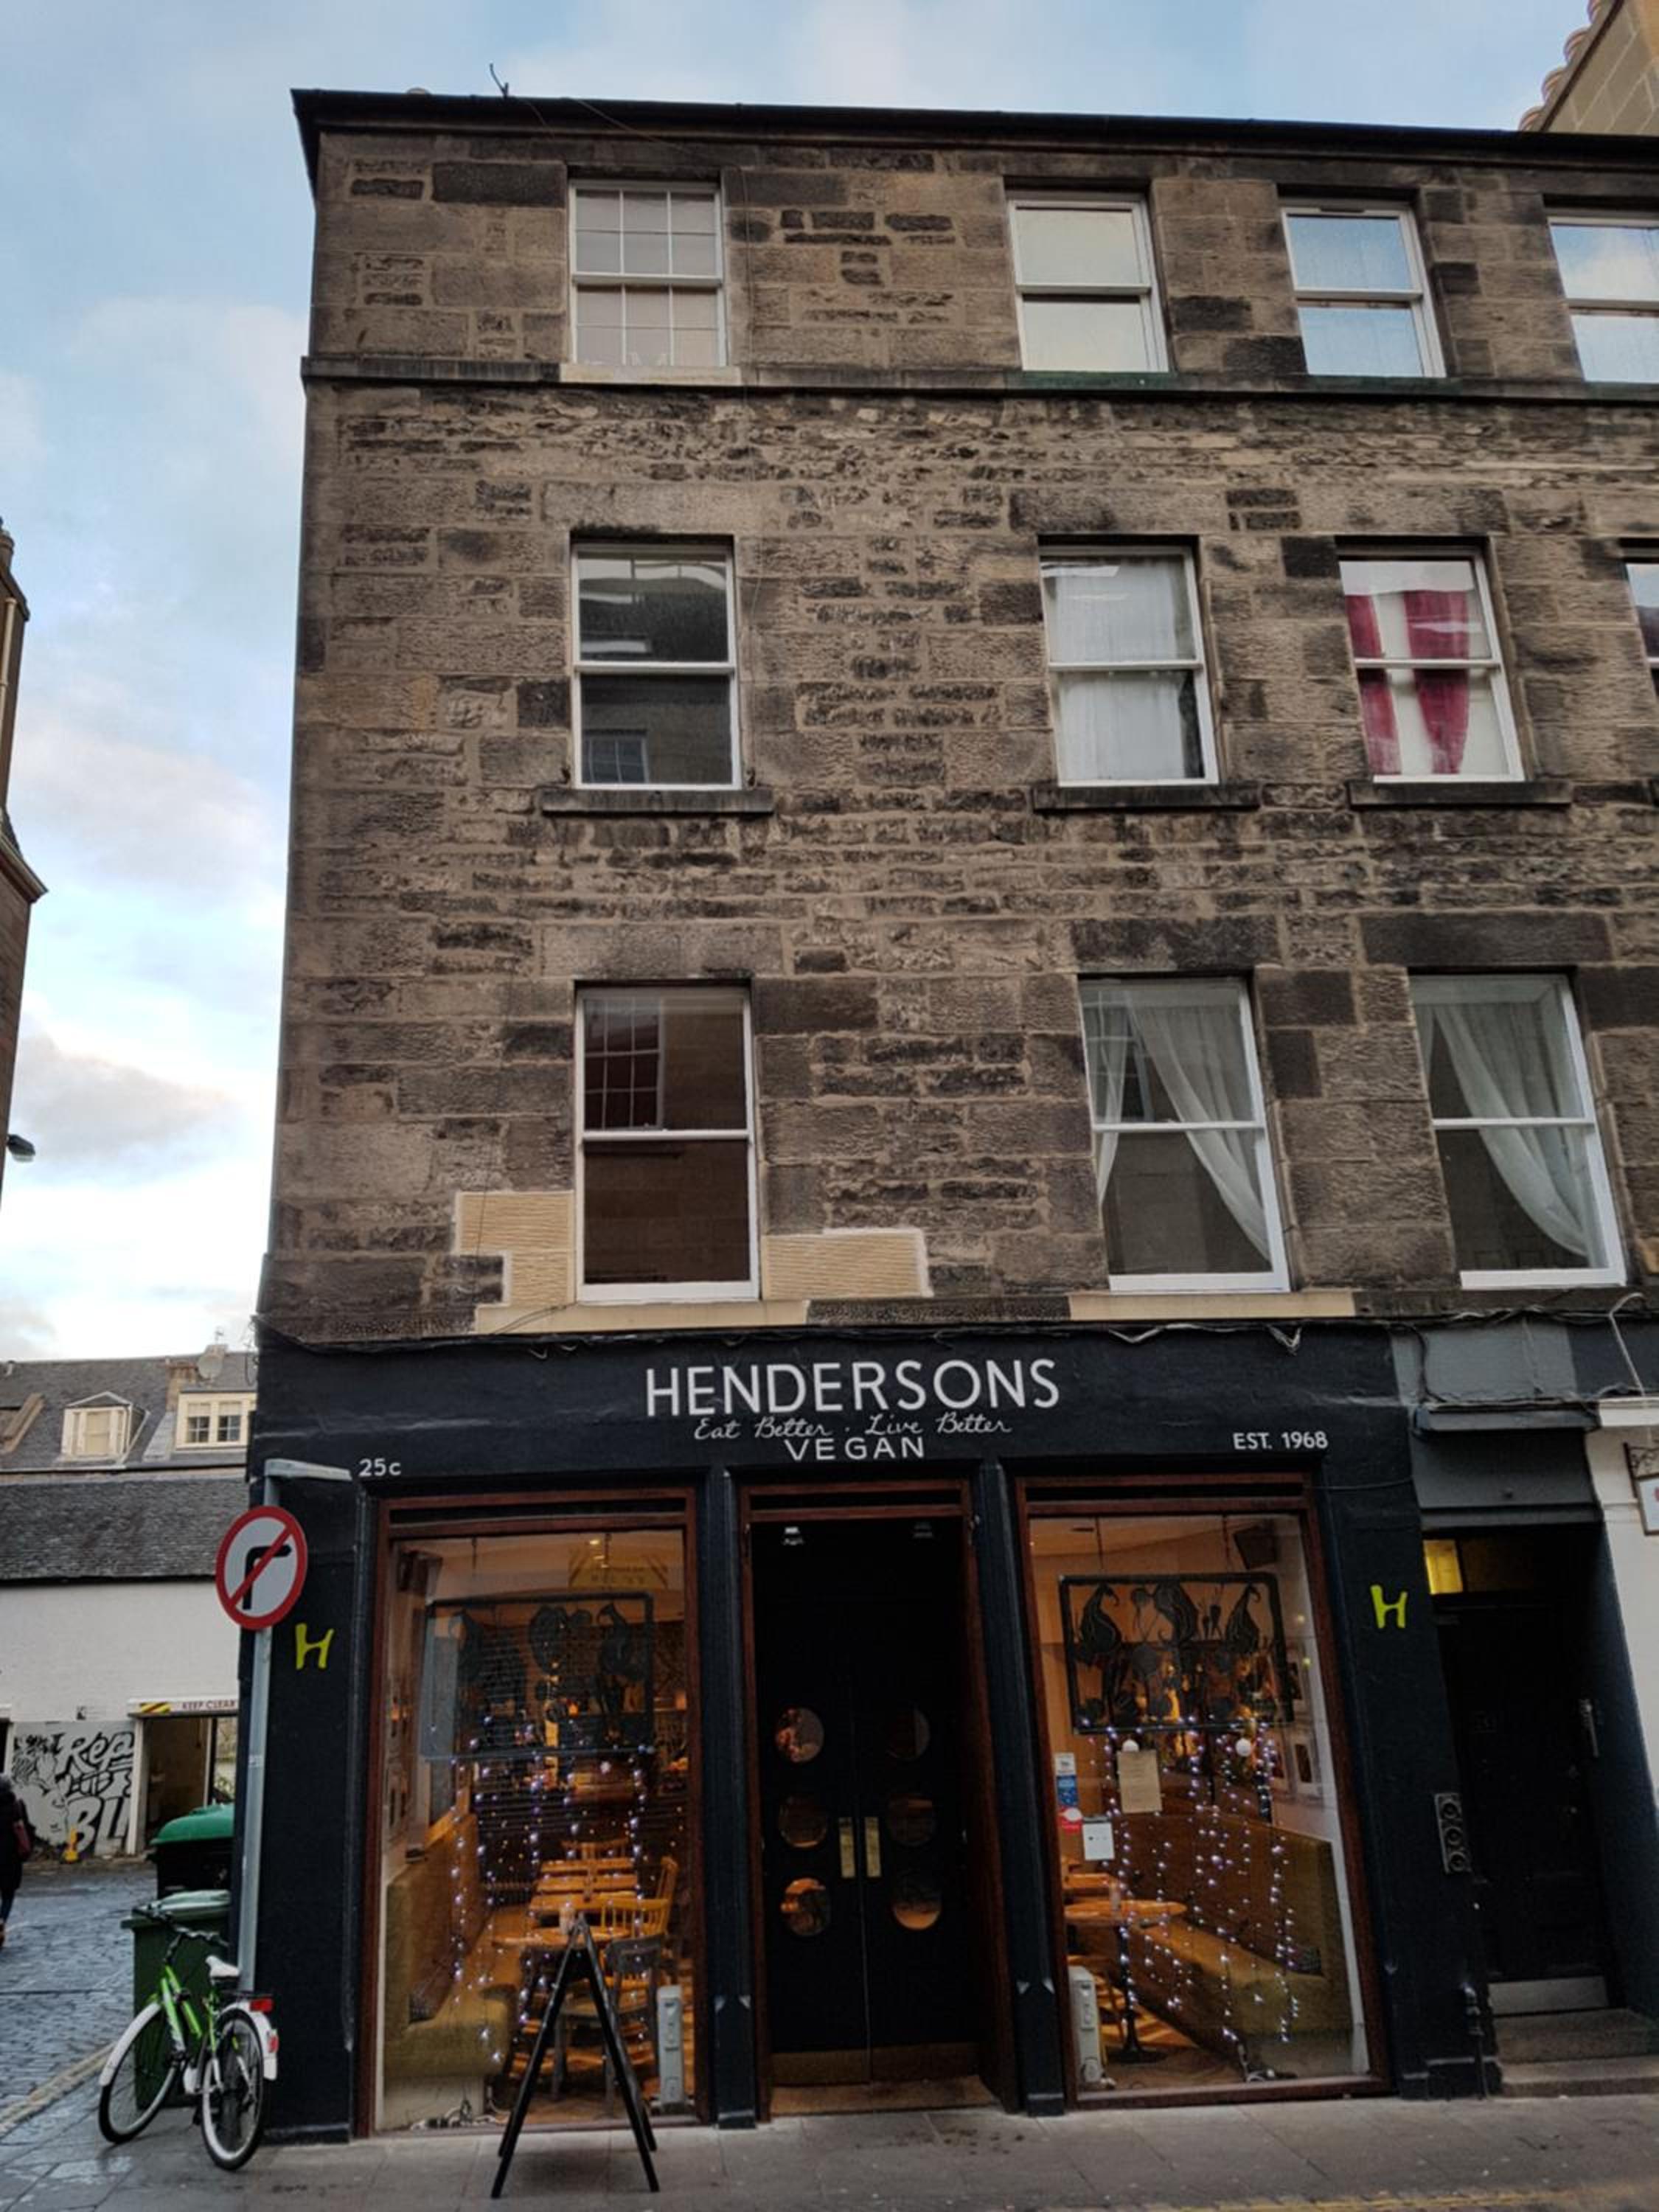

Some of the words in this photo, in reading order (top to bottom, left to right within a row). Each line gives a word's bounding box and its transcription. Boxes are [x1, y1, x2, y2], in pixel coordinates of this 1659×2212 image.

[647, 1358, 1060, 1416] HENDERSONS
[695, 1418, 742, 1440] Eat
[754, 1416, 832, 1439] Better
[865, 1413, 923, 1436] Live
[936, 1411, 1012, 1433] Better
[1233, 1431, 1273, 1450] EST.
[1281, 1430, 1329, 1450] 1968
[784, 1436, 925, 1461] VEGAN
[358, 1458, 402, 1478] 25c
[1370, 1584, 1408, 1630] H
[295, 1622, 335, 1671] H
